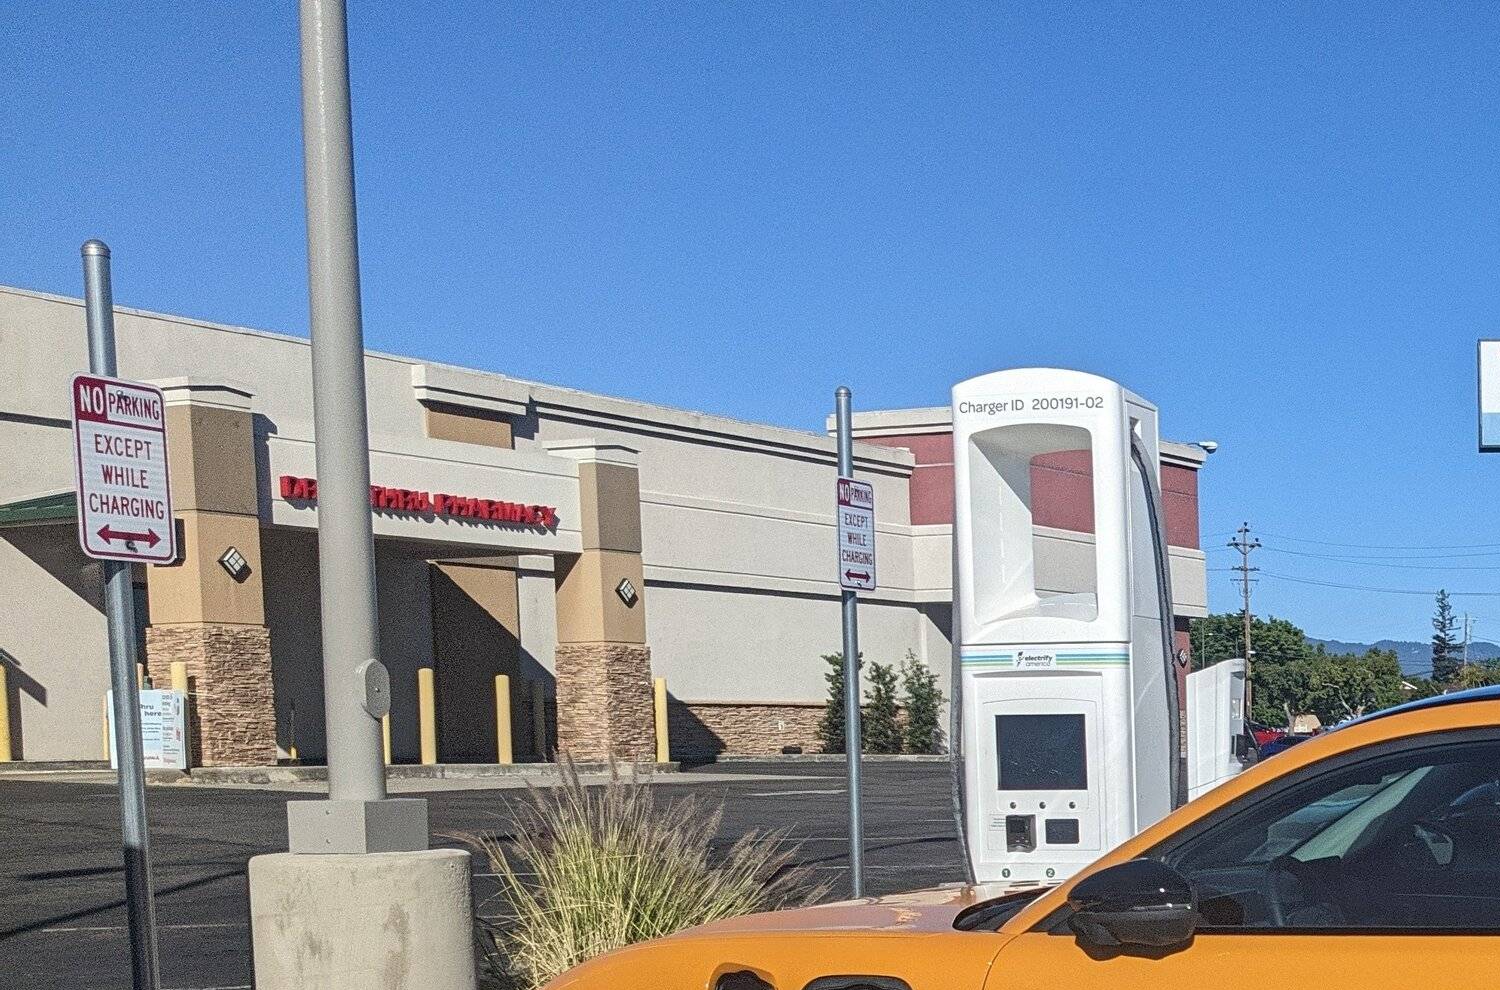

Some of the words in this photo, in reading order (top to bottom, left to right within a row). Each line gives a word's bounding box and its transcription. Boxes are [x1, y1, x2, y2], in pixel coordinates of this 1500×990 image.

[79, 384, 104, 415] NO
[108, 392, 160, 420] PARKING
[959, 402, 1008, 416] Charger
[1011, 399, 1024, 411] ID
[1032, 396, 1104, 410] 200191-02
[94, 433, 151, 460] EXCEPT
[101, 464, 149, 489] WHILE
[839, 483, 850, 502] NO
[89, 493, 165, 520] CHARGING
[845, 514, 868, 528] EXCEPT
[848, 533, 867, 546] WHILE
[842, 550, 872, 565] CHARGING
[1025, 655, 1052, 665] electrify
